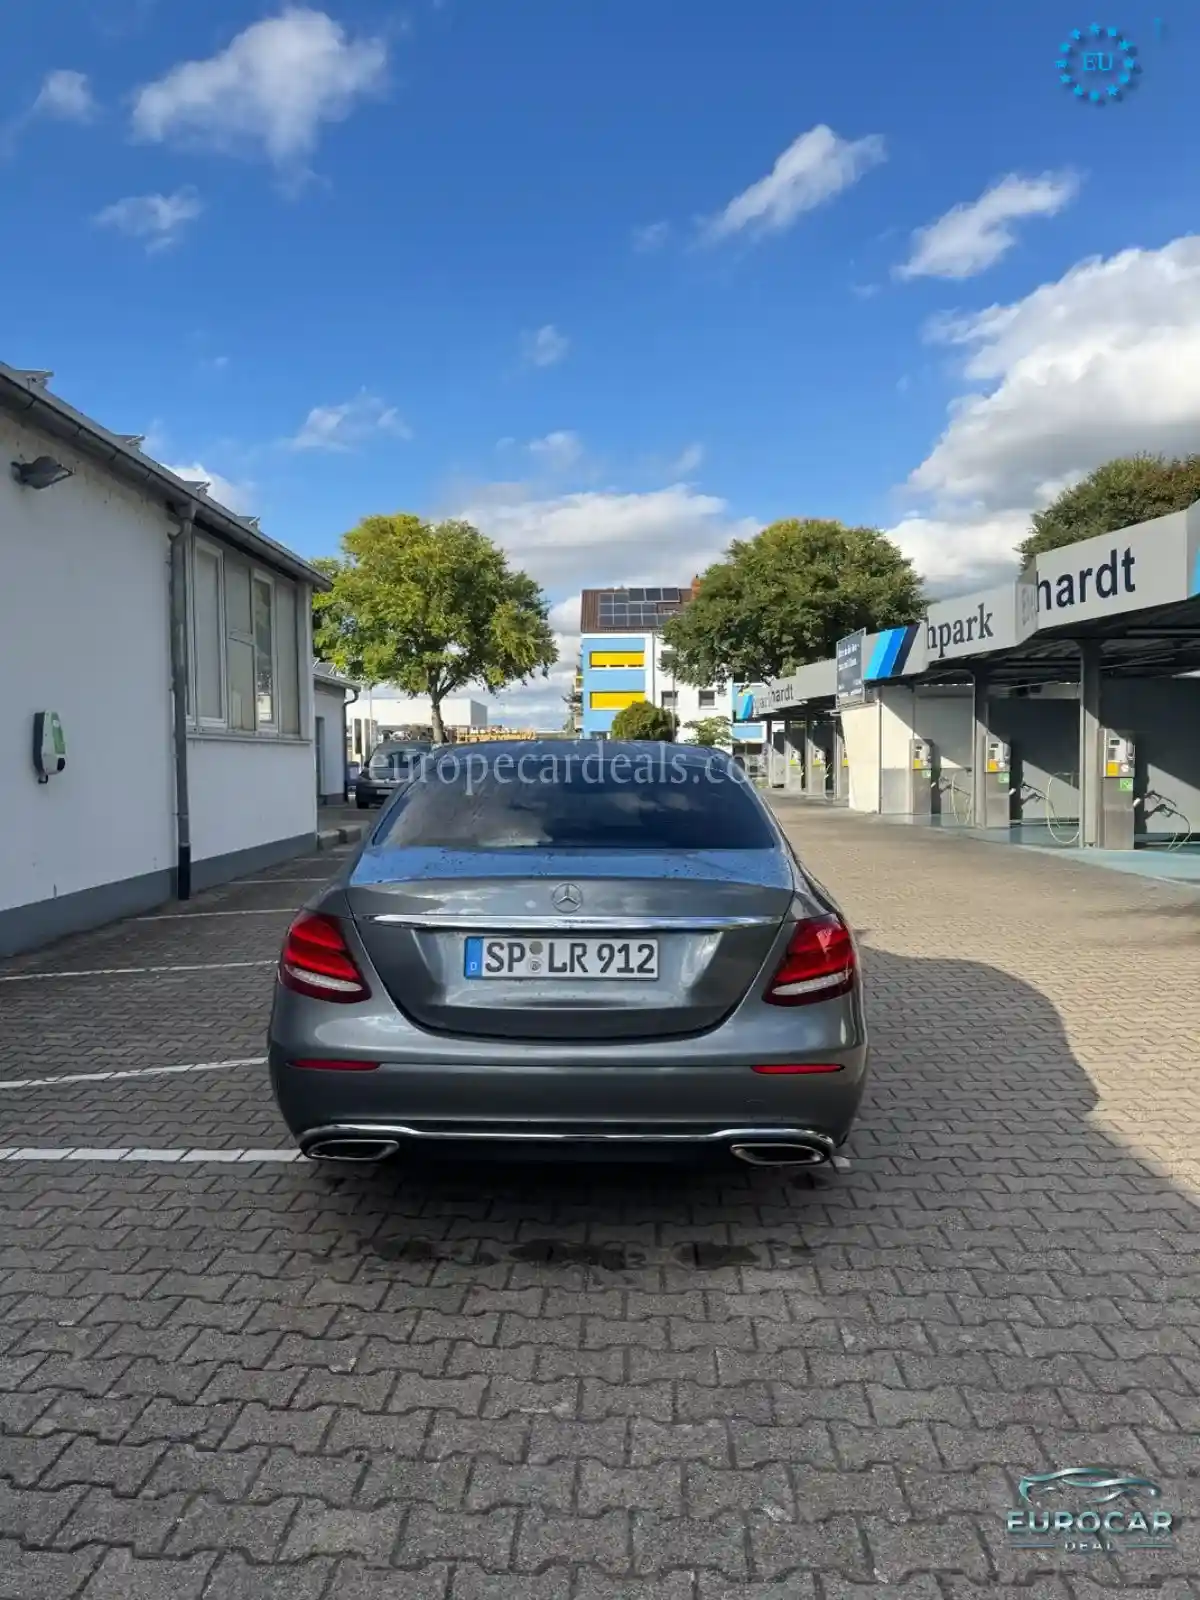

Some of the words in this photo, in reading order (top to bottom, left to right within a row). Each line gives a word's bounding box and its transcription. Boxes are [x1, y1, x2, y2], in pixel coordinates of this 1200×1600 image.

[485, 942, 526, 973] SP
[548, 942, 589, 973] LR
[596, 943, 656, 974] 912
